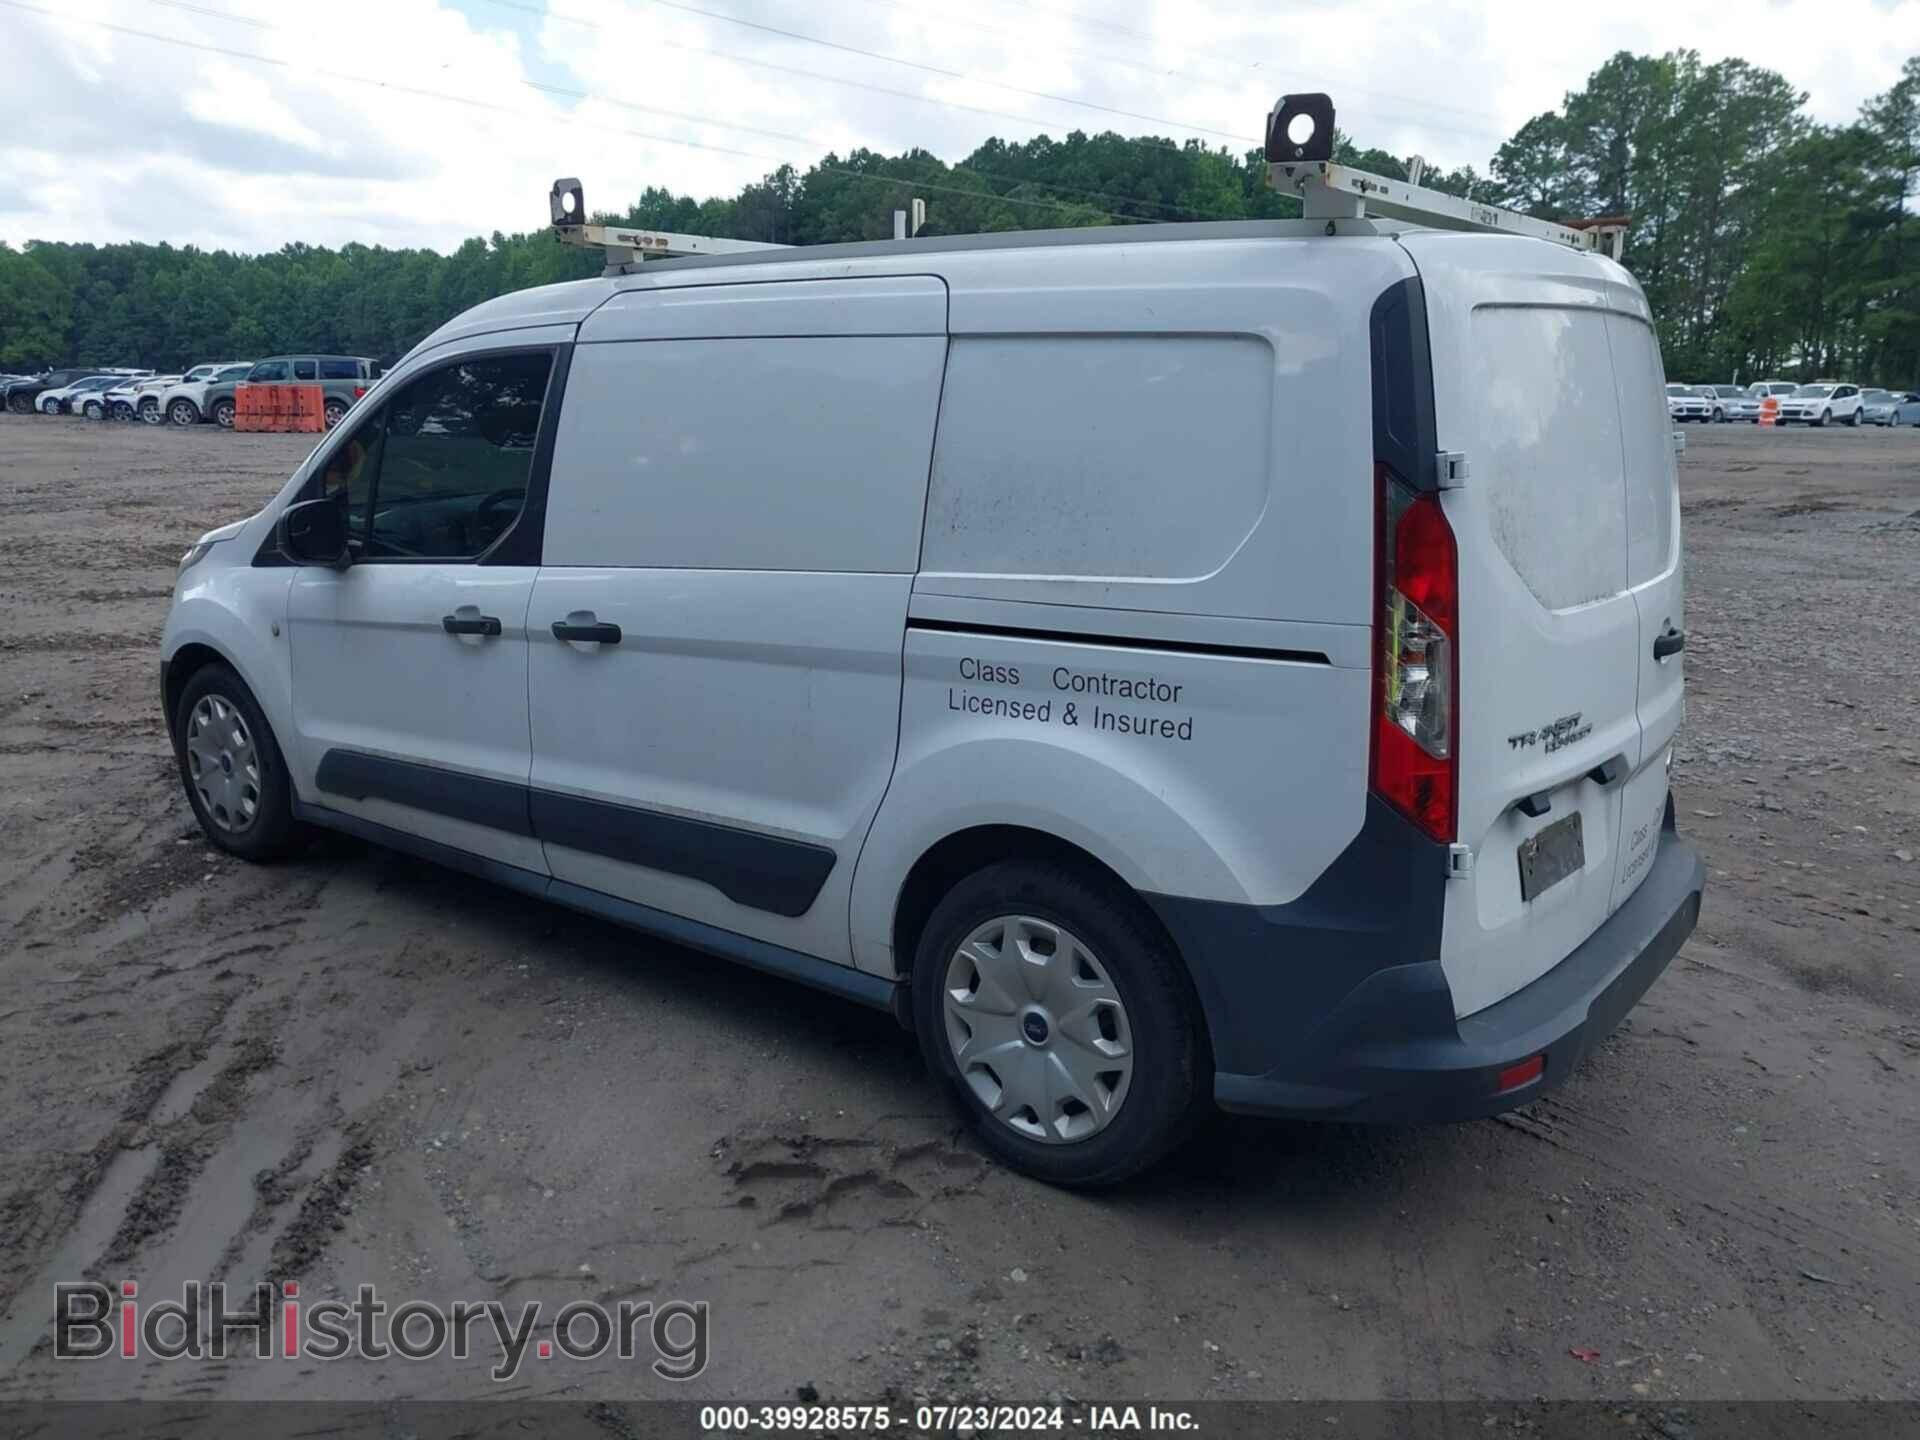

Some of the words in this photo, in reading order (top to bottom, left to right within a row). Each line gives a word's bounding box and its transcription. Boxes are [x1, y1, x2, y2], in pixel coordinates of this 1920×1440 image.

[959, 657, 1020, 686] Class
[1052, 666, 1183, 703] Contractor
[948, 688, 1052, 723] Licensed
[1062, 702, 1079, 727] &
[1093, 705, 1193, 741] Insured
